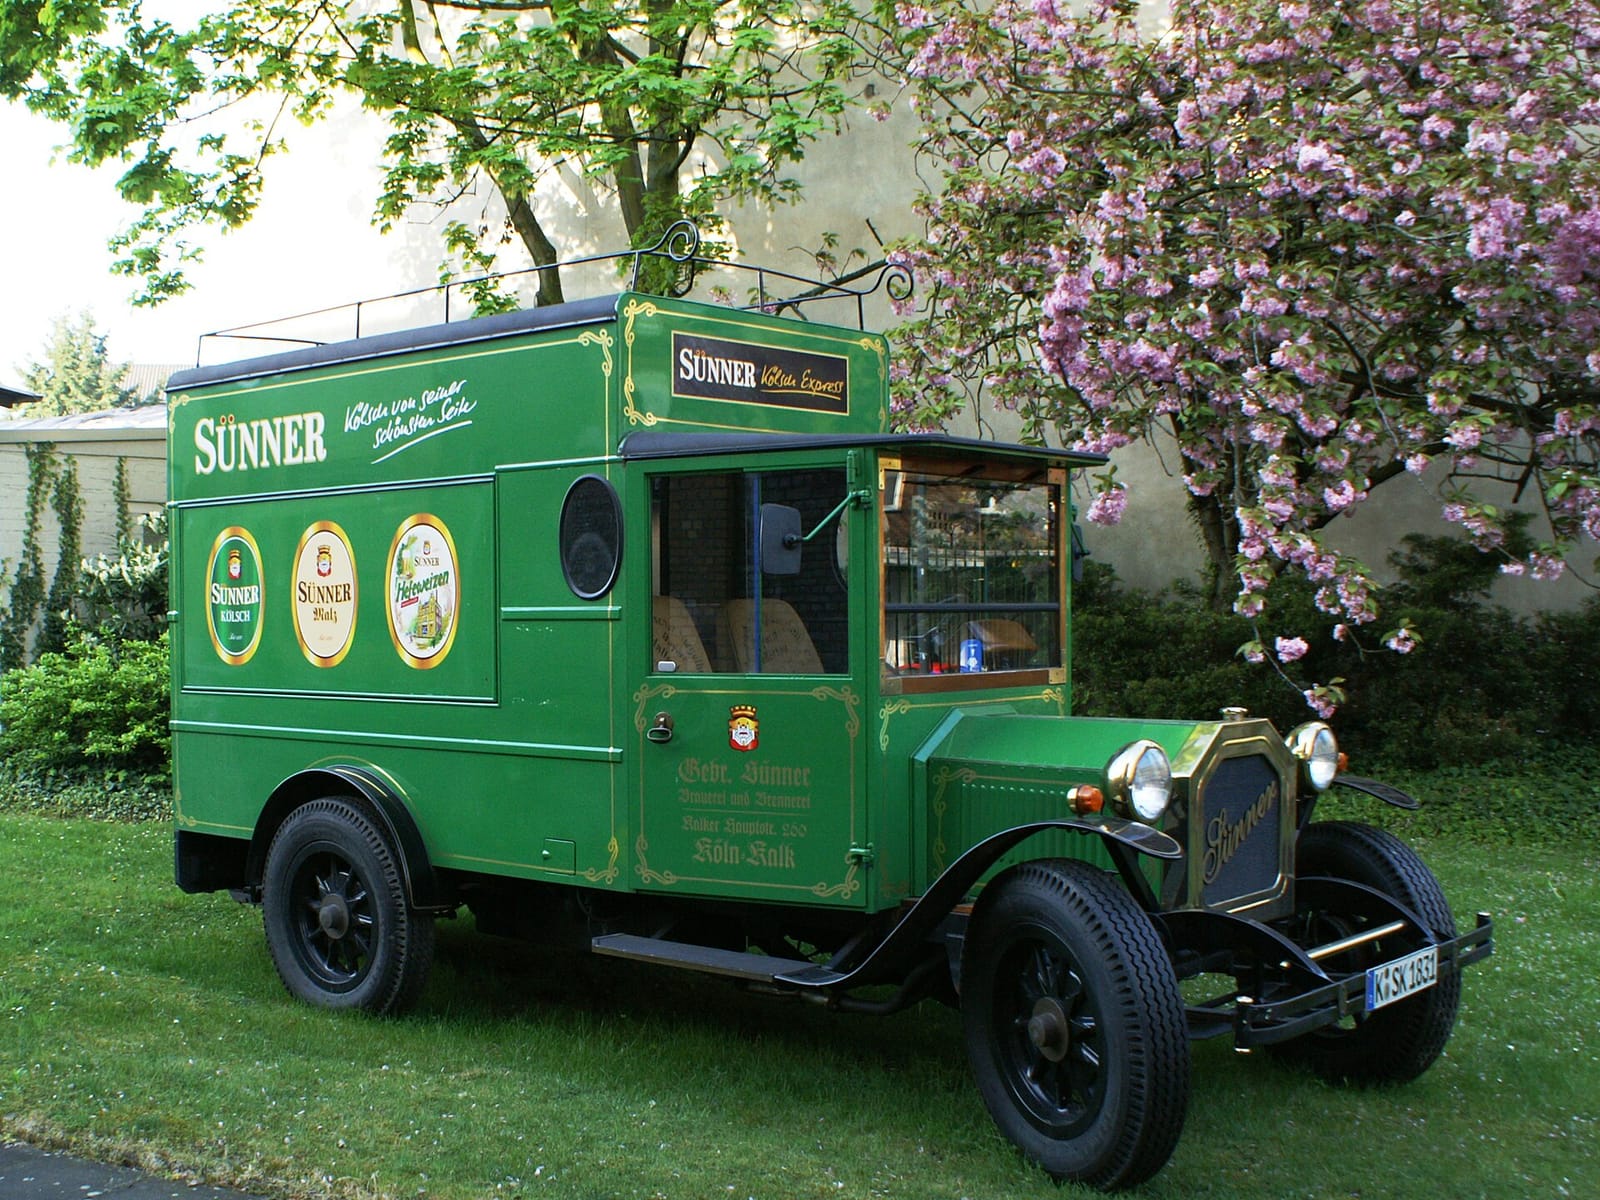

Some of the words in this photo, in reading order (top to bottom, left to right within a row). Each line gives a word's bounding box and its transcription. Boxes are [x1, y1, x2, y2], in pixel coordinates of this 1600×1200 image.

[679, 347, 756, 388] SÜNNER
[800, 368, 844, 396] Express
[344, 401, 389, 432] Kölsch
[391, 397, 416, 415] von
[418, 379, 468, 411] seiner
[193, 411, 327, 475] SÜNNER
[298, 580, 352, 604] SÜNNER
[395, 570, 450, 602] Hefeweizen
[220, 609, 251, 623] KÖLSCH
[312, 607, 338, 624] Malz
[678, 758, 733, 784] Gebr.
[740, 760, 811, 788] Sünner
[730, 792, 751, 807] und
[1408, 952, 1436, 990] 1831
